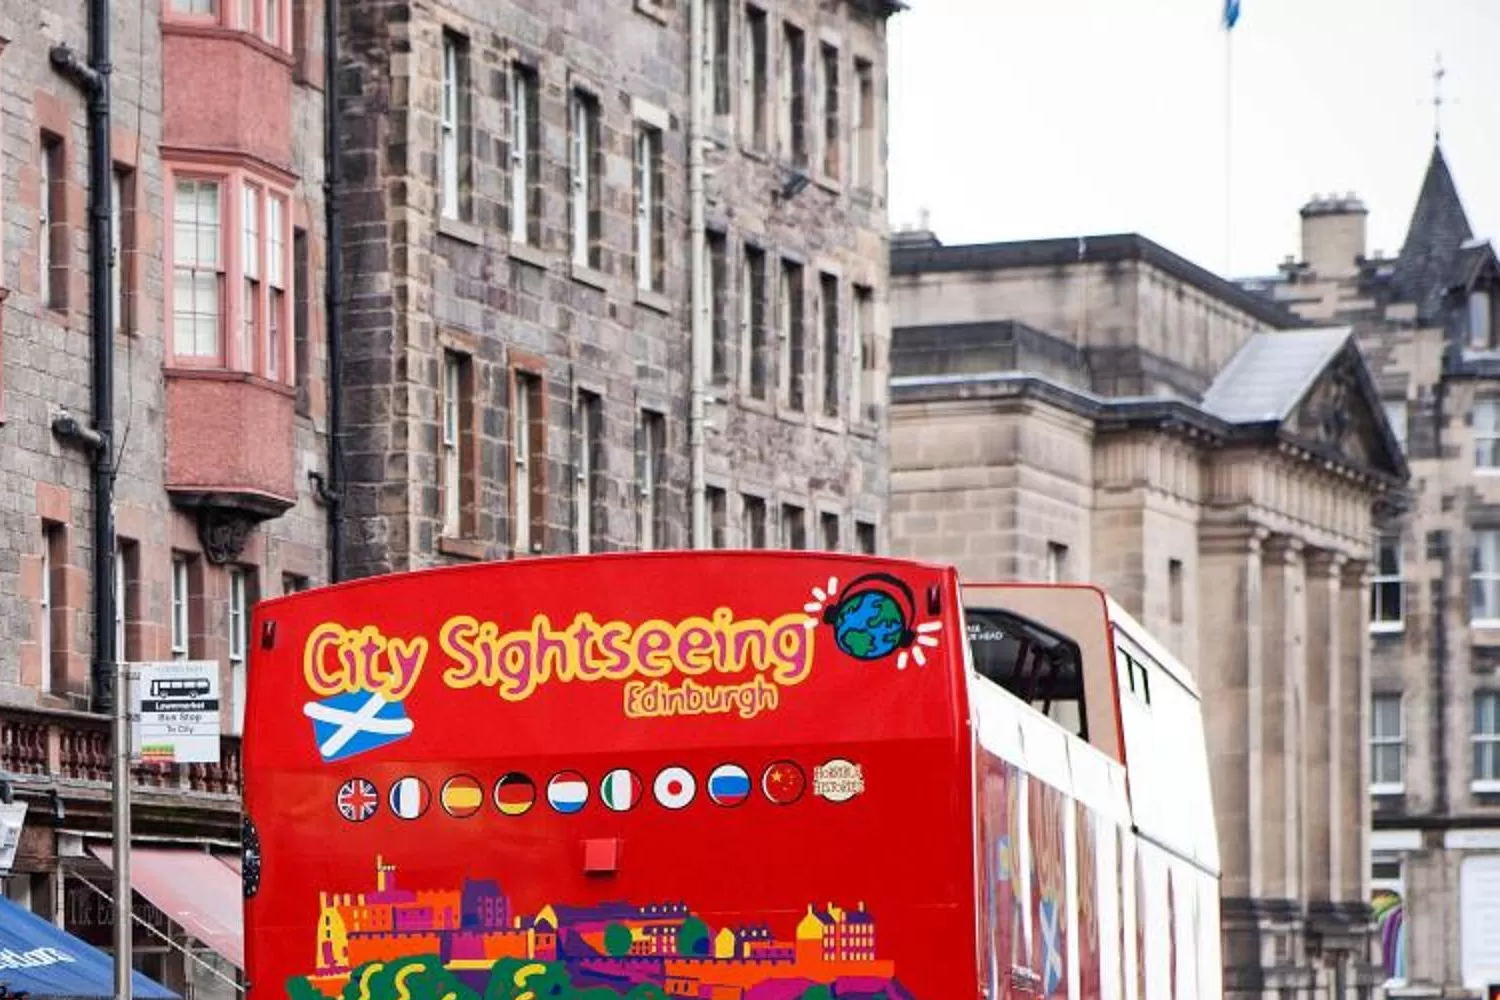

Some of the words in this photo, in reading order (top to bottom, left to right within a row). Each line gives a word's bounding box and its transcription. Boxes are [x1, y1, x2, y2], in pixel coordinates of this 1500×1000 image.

[305, 623, 428, 699] City
[440, 608, 814, 701] Sightseeing
[158, 713, 177, 721] Bus
[180, 711, 202, 722] Stop
[625, 677, 778, 717] Edinburgh
